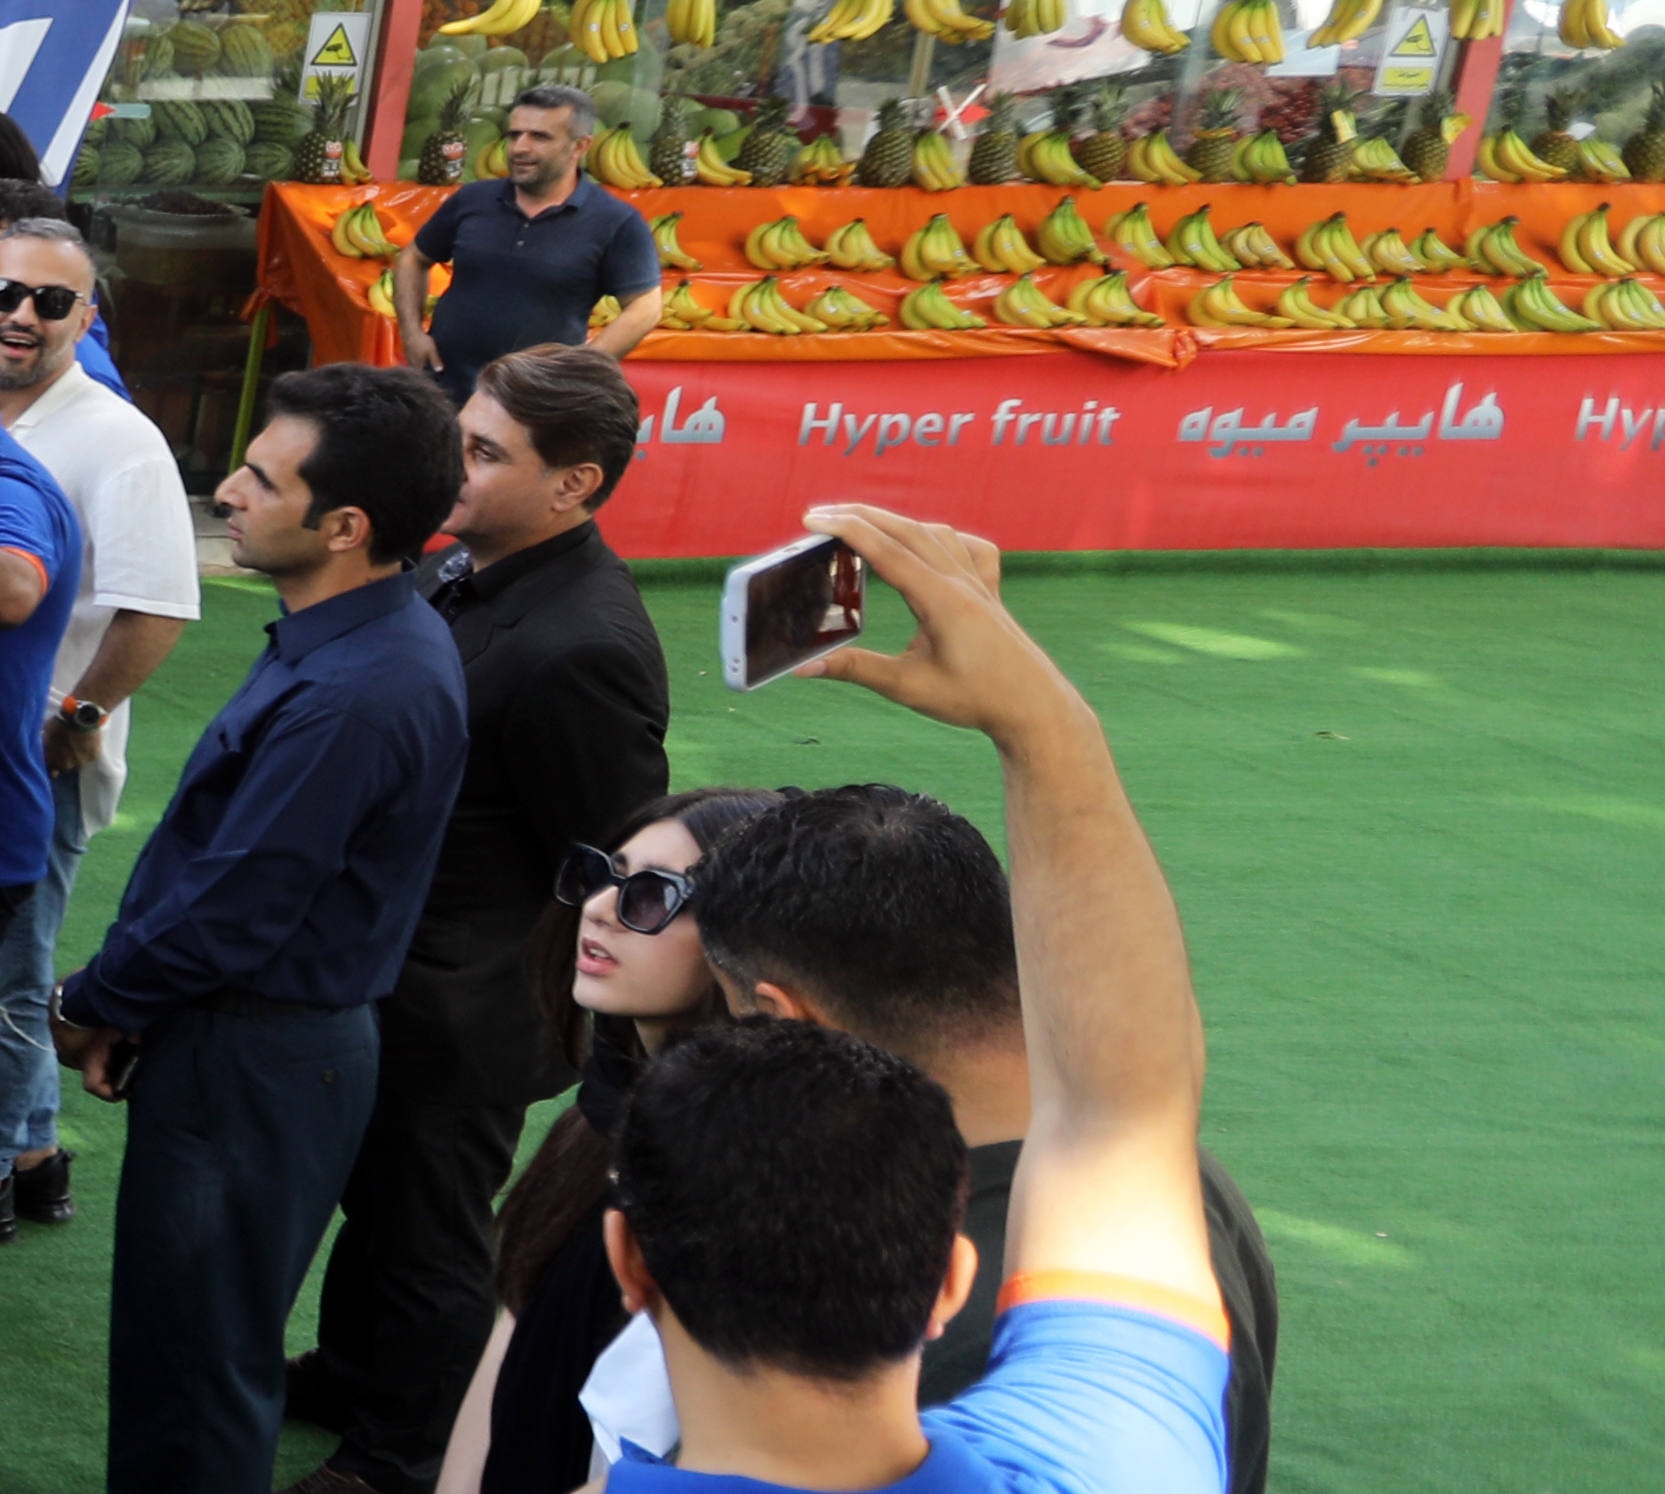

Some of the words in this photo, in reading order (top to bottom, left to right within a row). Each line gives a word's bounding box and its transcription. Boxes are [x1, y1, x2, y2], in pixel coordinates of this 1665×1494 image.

[797, 400, 975, 457] Hyper
[990, 397, 1122, 446] fruit
[1176, 404, 1320, 460] میوه
[1331, 381, 1505, 468] هایپر
